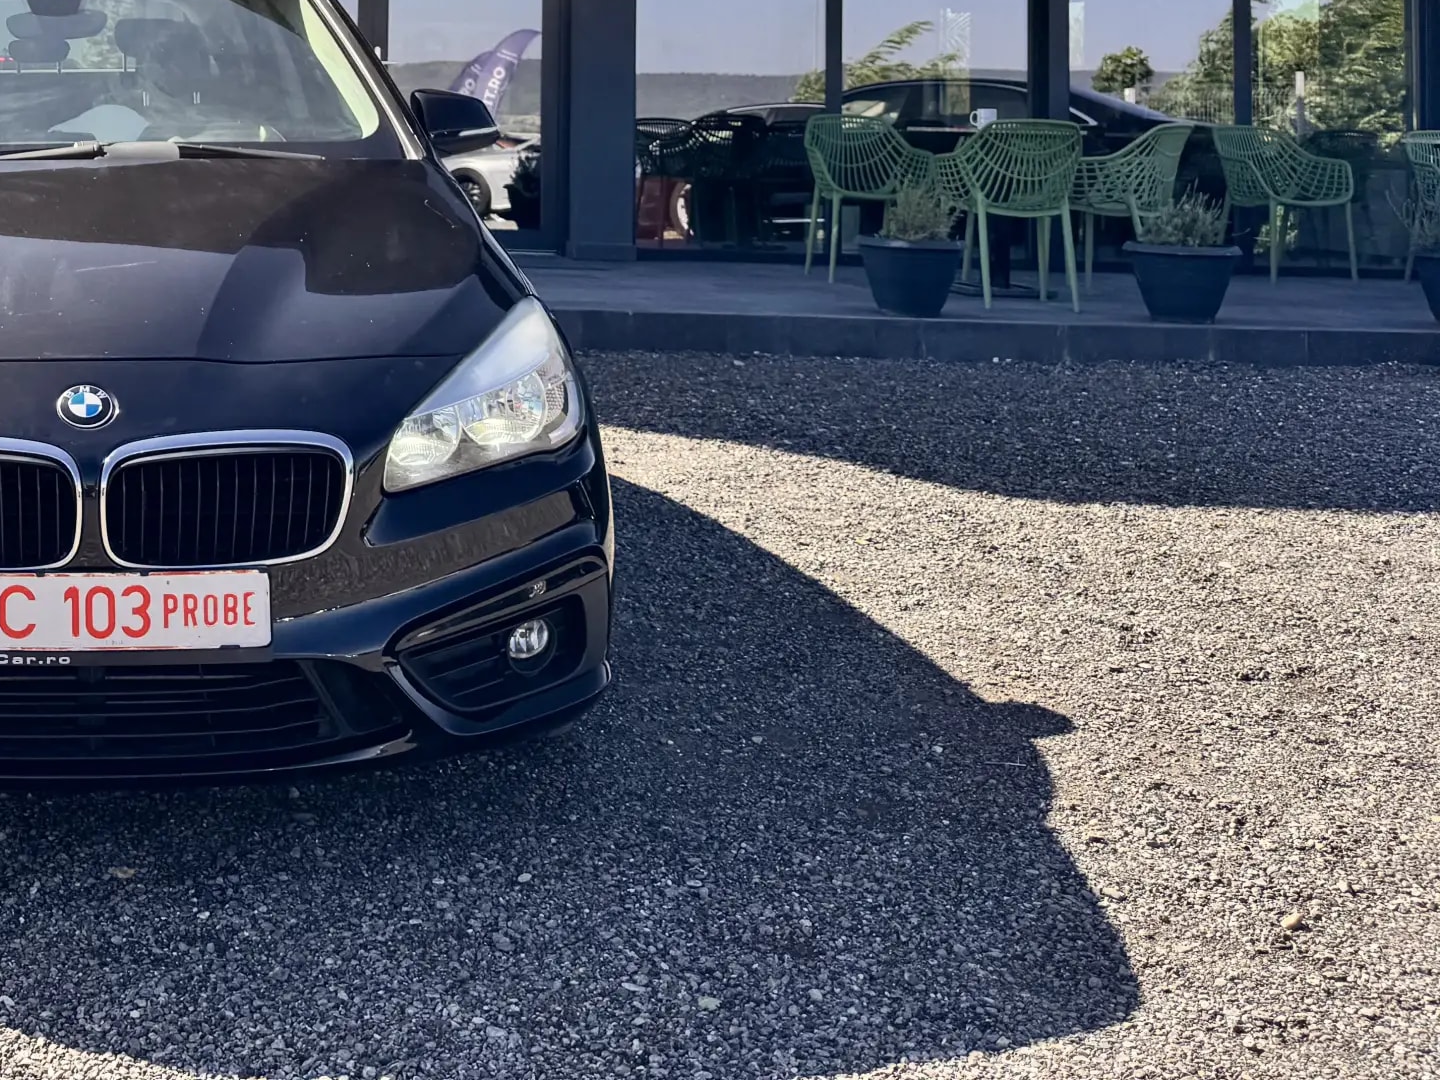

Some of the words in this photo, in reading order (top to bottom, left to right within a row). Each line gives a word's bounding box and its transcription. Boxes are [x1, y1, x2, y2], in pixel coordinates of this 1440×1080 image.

[482, 66, 506, 107] IT.RO
[63, 385, 109, 399] BMW
[64, 585, 151, 639] 103
[163, 591, 256, 629] PROBE
